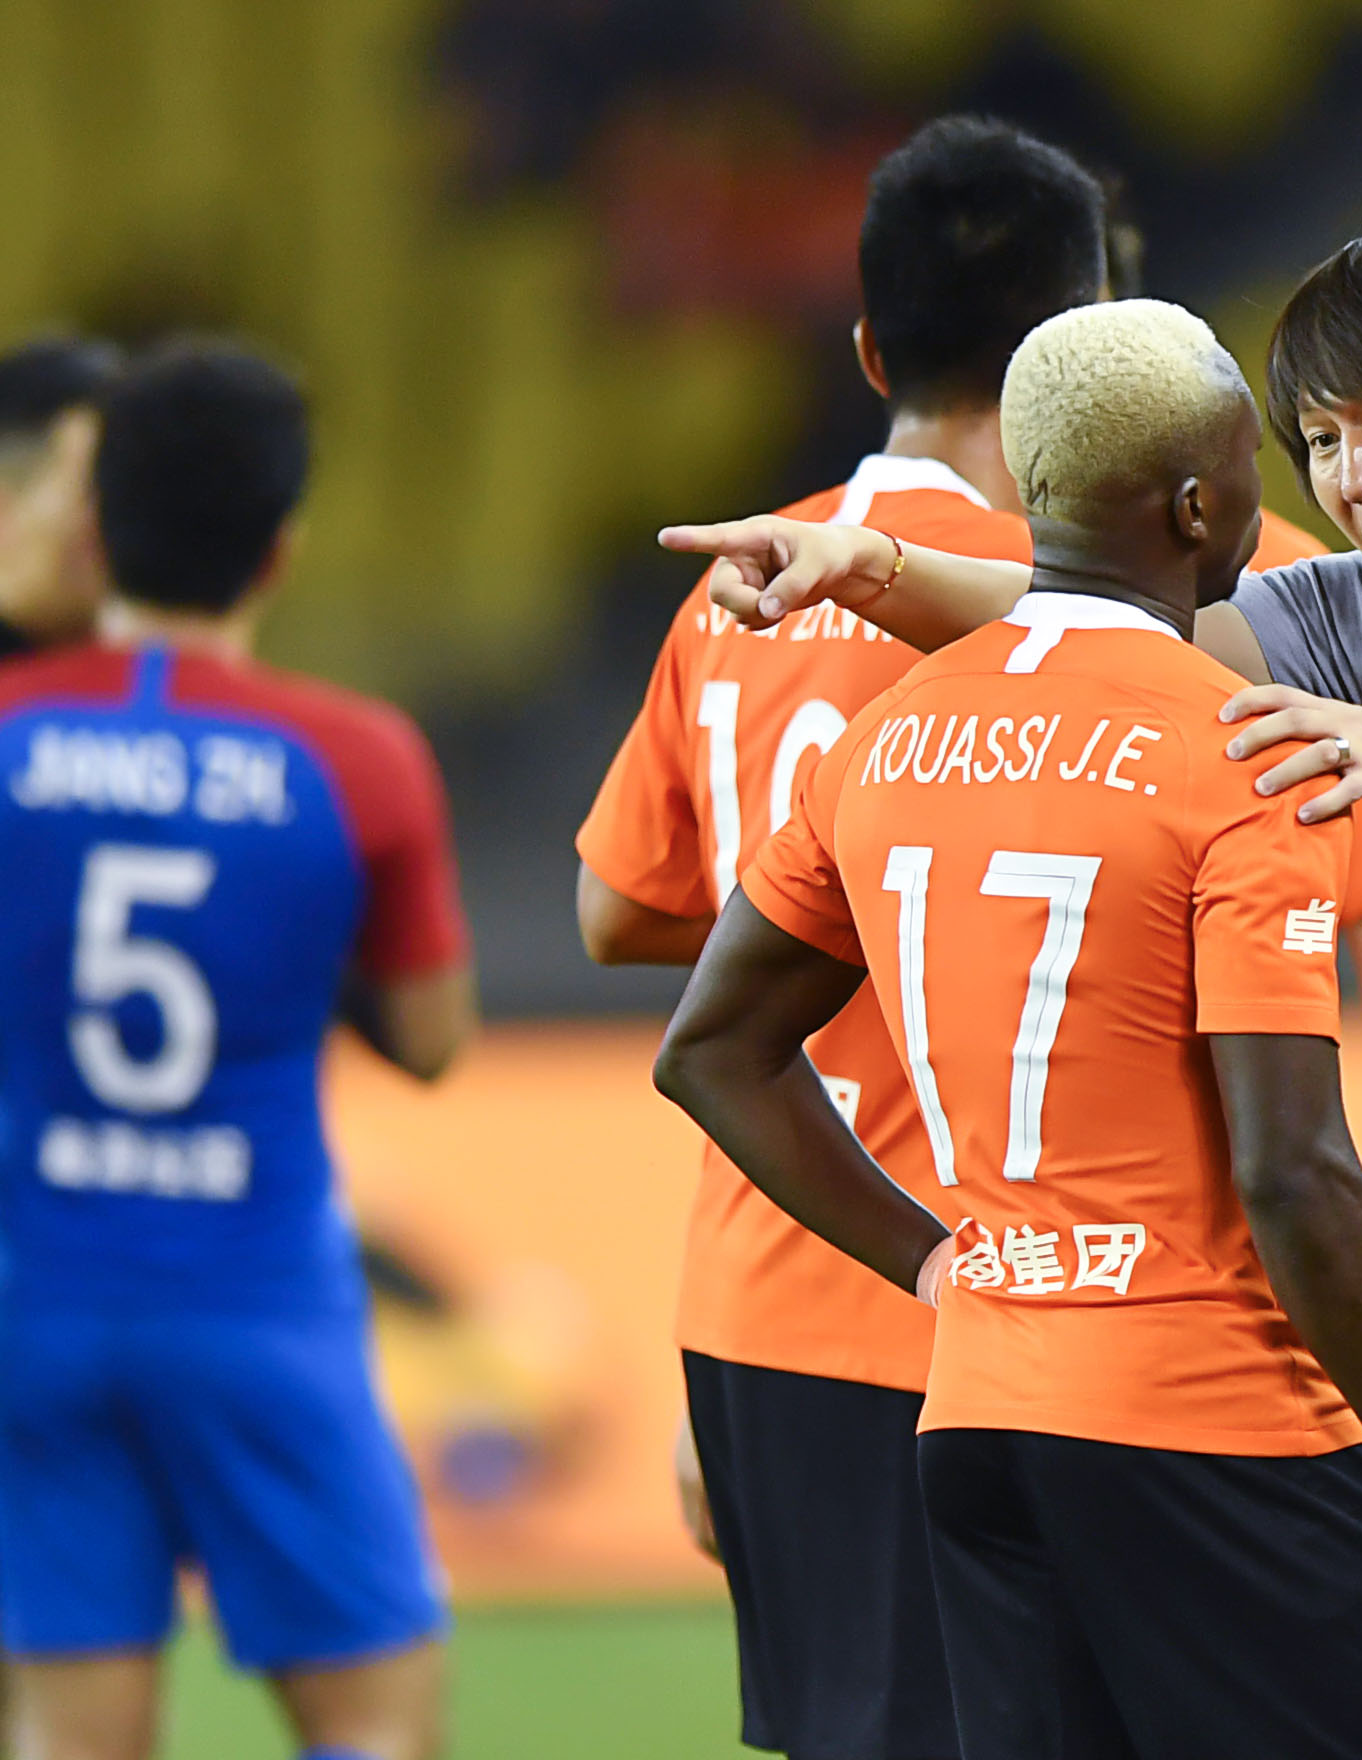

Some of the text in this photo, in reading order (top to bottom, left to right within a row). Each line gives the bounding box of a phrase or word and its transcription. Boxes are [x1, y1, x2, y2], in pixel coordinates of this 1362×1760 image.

[860, 714, 1162, 796] KOUASSI J.E.
[69, 843, 216, 1113] 5
[1282, 898, 1336, 954] 卓
[881, 846, 1103, 1186] 17
